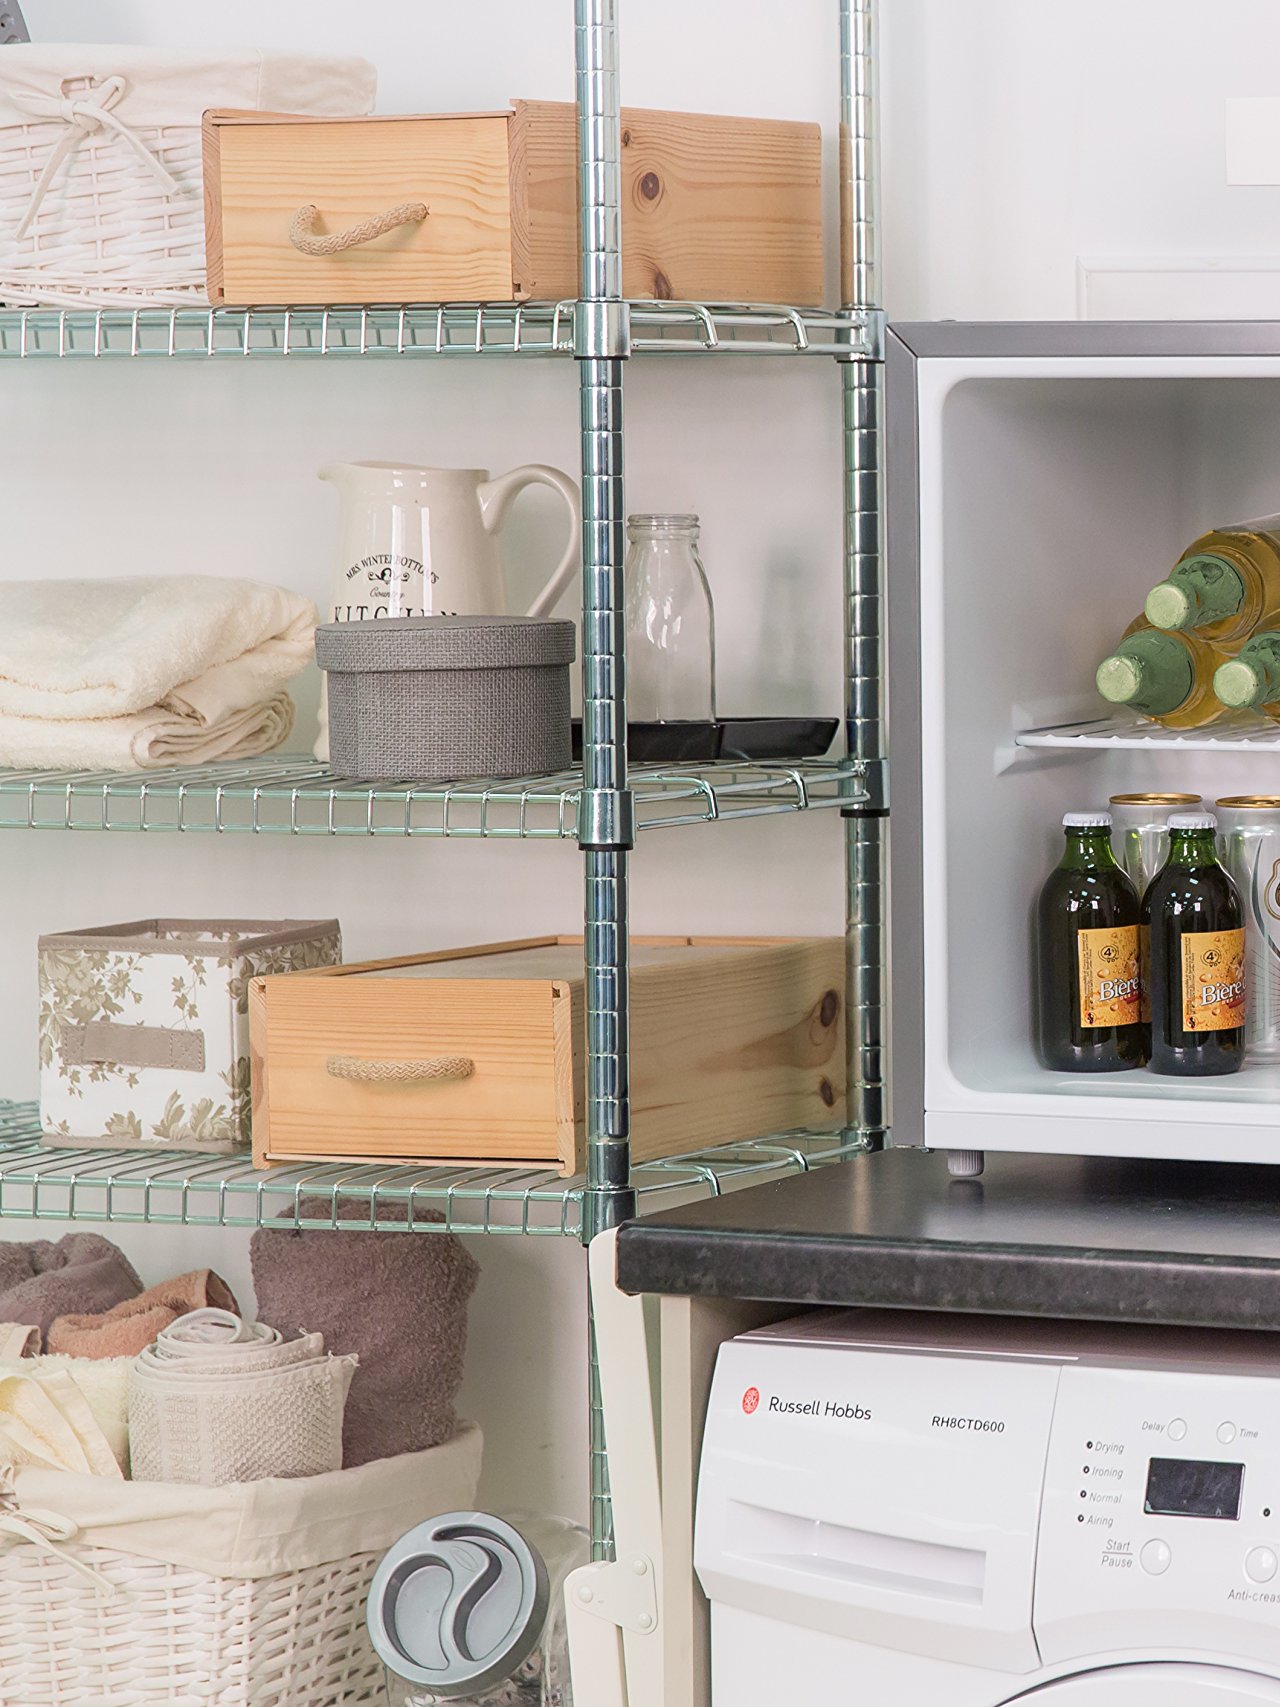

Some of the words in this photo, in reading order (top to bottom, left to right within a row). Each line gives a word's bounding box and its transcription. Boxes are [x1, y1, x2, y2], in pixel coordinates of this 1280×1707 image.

[346, 563, 362, 580] MRS
[361, 554, 440, 585] WINTEBOTTO'S
[369, 586, 405, 599] Couny
[334, 605, 457, 623] KITC
[1099, 976, 1140, 1002] Bière
[1200, 981, 1242, 1007] Bière
[769, 1396, 820, 1416] Russell
[825, 1403, 872, 1421] Hobbs
[931, 1415, 1005, 1433] RH8CTD600
[1141, 1421, 1166, 1433] Delay
[1239, 1428, 1259, 1439] Time
[1094, 1441, 1125, 1455] Drying
[1091, 1466, 1124, 1480] Ironing
[1088, 1493, 1122, 1504] Normal
[1086, 1515, 1114, 1528] Airing
[1105, 1539, 1131, 1552] Start
[1100, 1555, 1133, 1569] Pause
